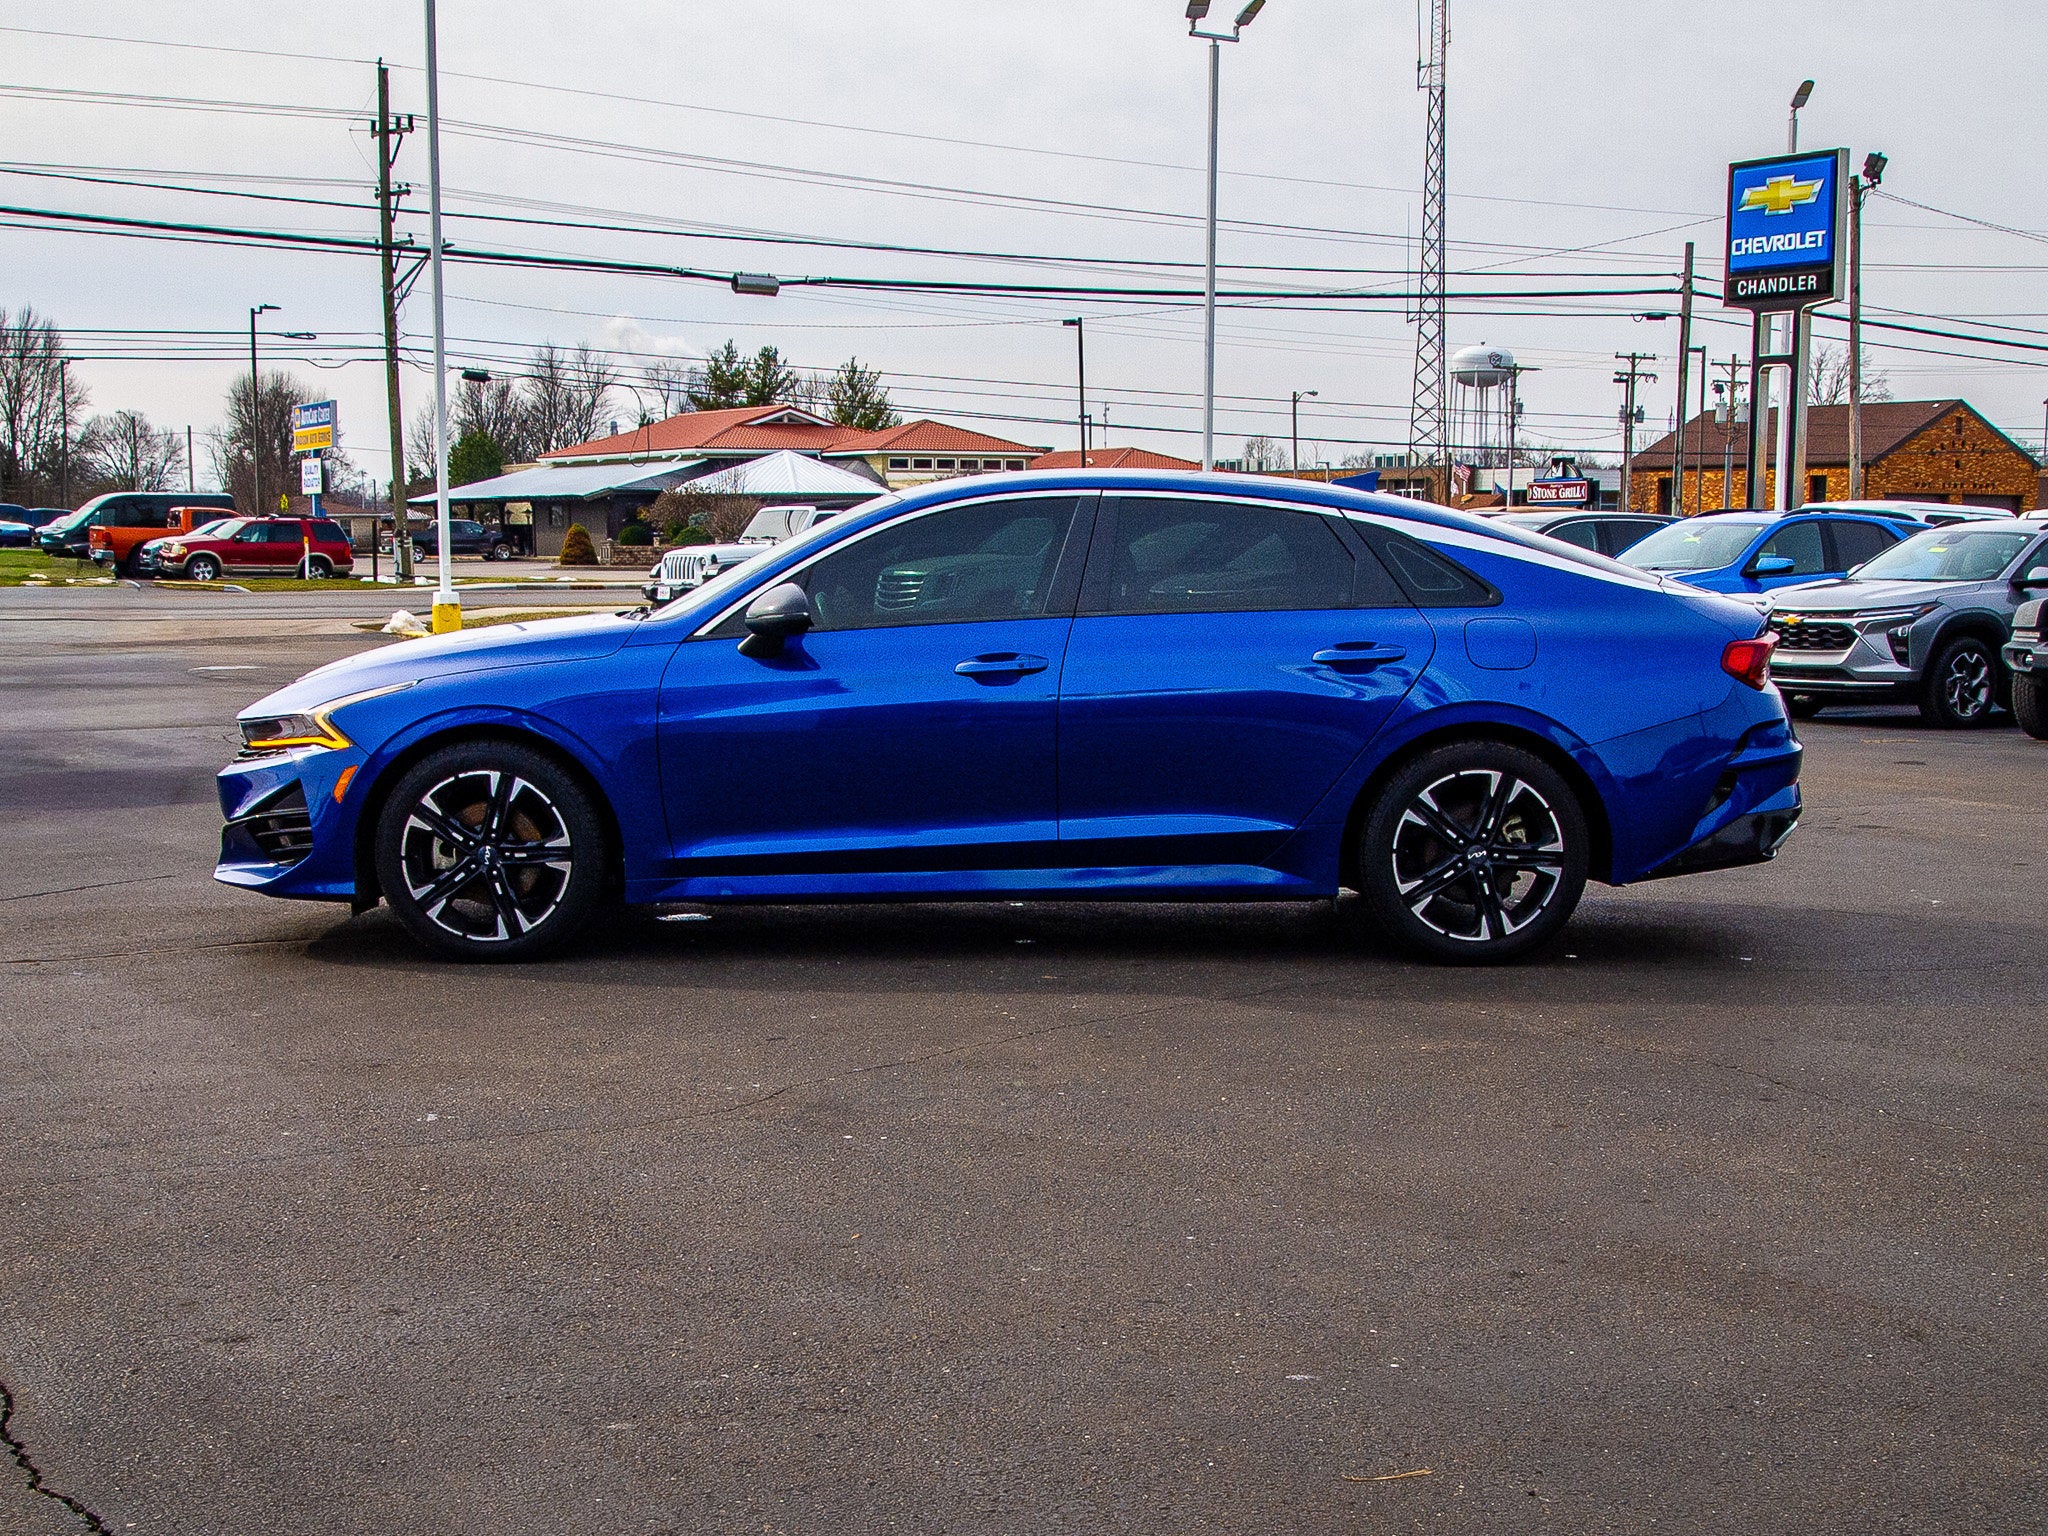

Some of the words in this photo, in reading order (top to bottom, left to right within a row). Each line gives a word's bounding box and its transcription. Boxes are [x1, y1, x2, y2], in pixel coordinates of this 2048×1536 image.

[1732, 230, 1826, 256] CHEVROLET
[1737, 275, 1817, 296] CHANDLER
[1532, 486, 1557, 499] STONE
[1559, 486, 1581, 498] GRILL
